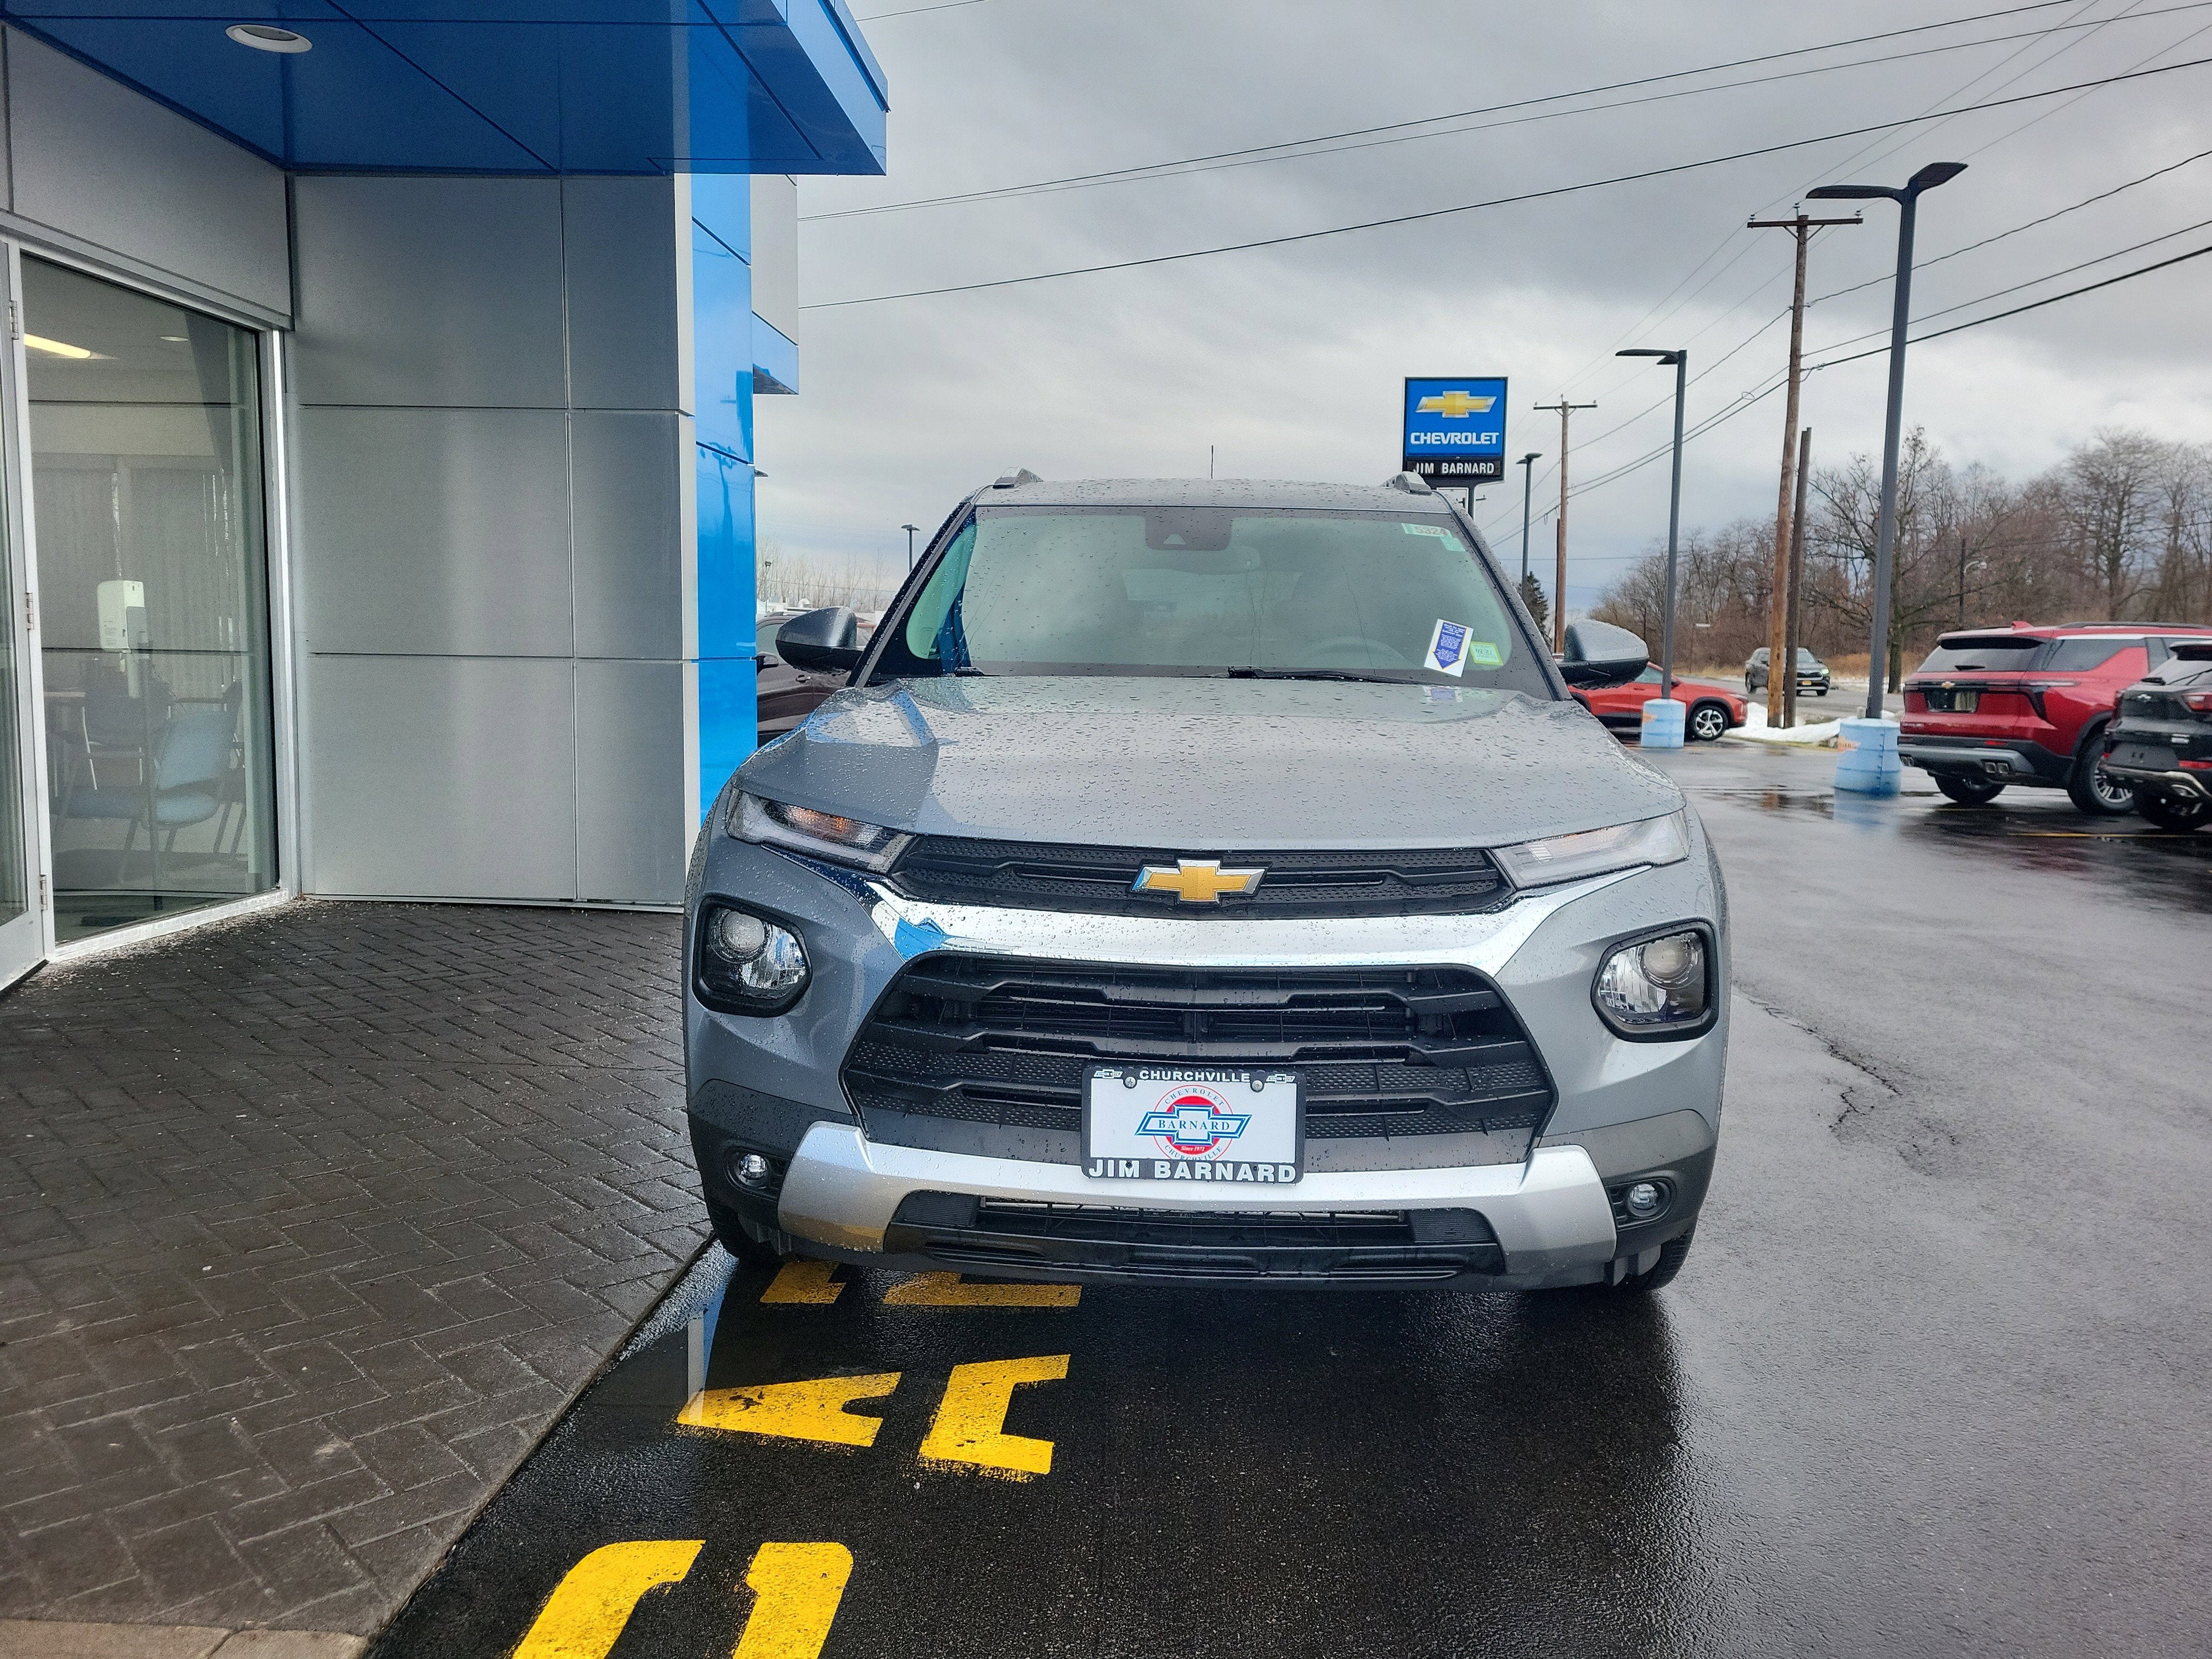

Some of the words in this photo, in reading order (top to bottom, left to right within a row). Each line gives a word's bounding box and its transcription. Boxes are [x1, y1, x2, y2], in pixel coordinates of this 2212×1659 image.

[1411, 432, 1500, 444] CHEVROLET
[1413, 462, 1434, 474] JIM
[1442, 462, 1495, 474] BARNARD
[1139, 1070, 1251, 1083] CHURCHVILLE
[1165, 1088, 1224, 1107] CHEVROLET
[1158, 1119, 1230, 1130] BARNARD
[1088, 1159, 1140, 1178] JIM
[1154, 1161, 1296, 1182] BARNARD
